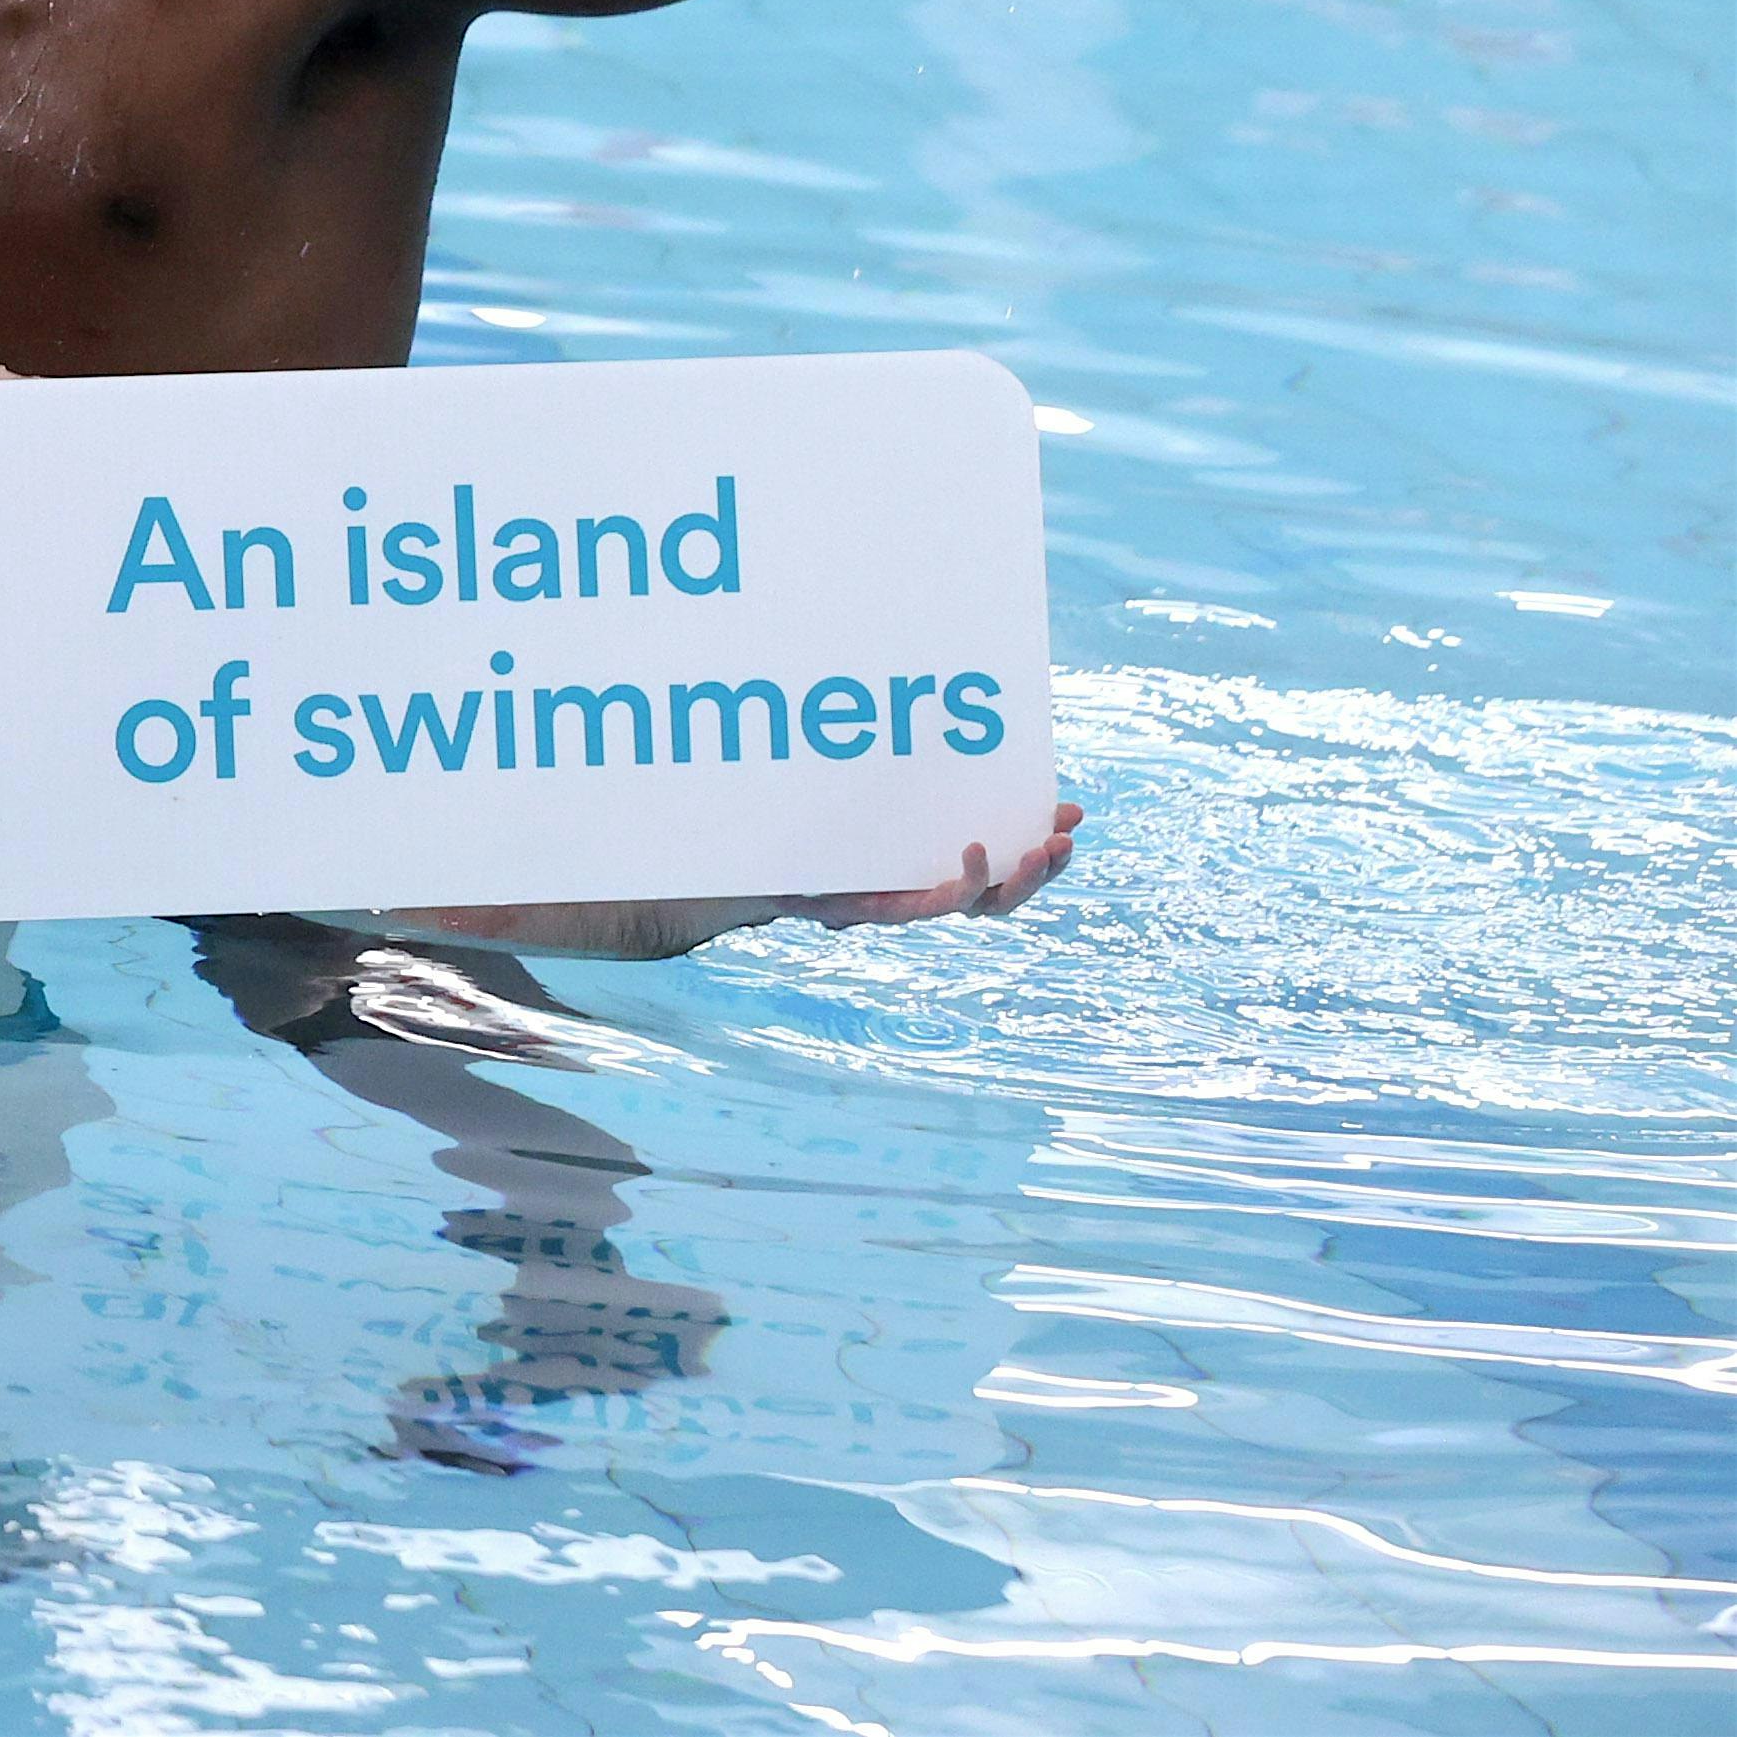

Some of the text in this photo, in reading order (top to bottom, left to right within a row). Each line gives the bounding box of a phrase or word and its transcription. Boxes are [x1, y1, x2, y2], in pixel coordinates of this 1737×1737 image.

[106, 475, 741, 613] An island
[115, 650, 1005, 784] of swimmers
